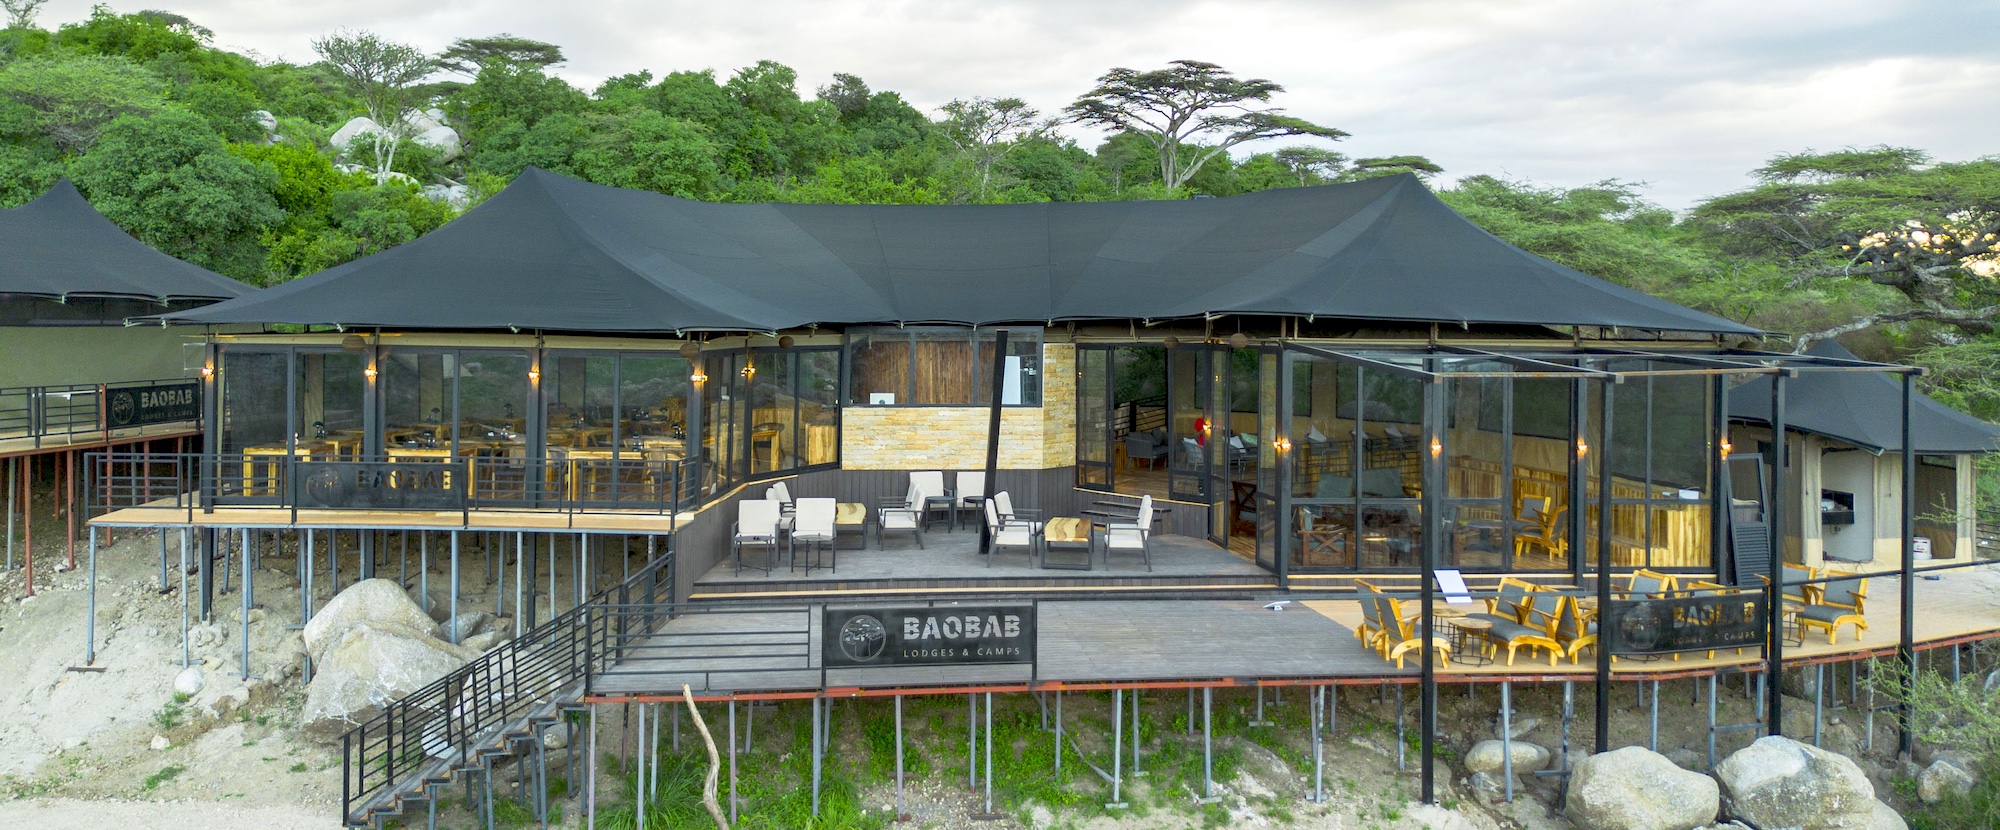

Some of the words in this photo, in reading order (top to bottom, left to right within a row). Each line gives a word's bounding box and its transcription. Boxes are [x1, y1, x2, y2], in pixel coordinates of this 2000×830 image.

[141, 389, 193, 408] BAOBAB
[358, 470, 451, 490] BAOBAB
[1673, 601, 1755, 628] BAOBB
[903, 614, 1021, 640] BAOBAB
[1724, 631, 1755, 641] CAMPS
[903, 648, 954, 658] LODGES
[962, 648, 969, 656] &
[976, 647, 1021, 656] CAMPS
